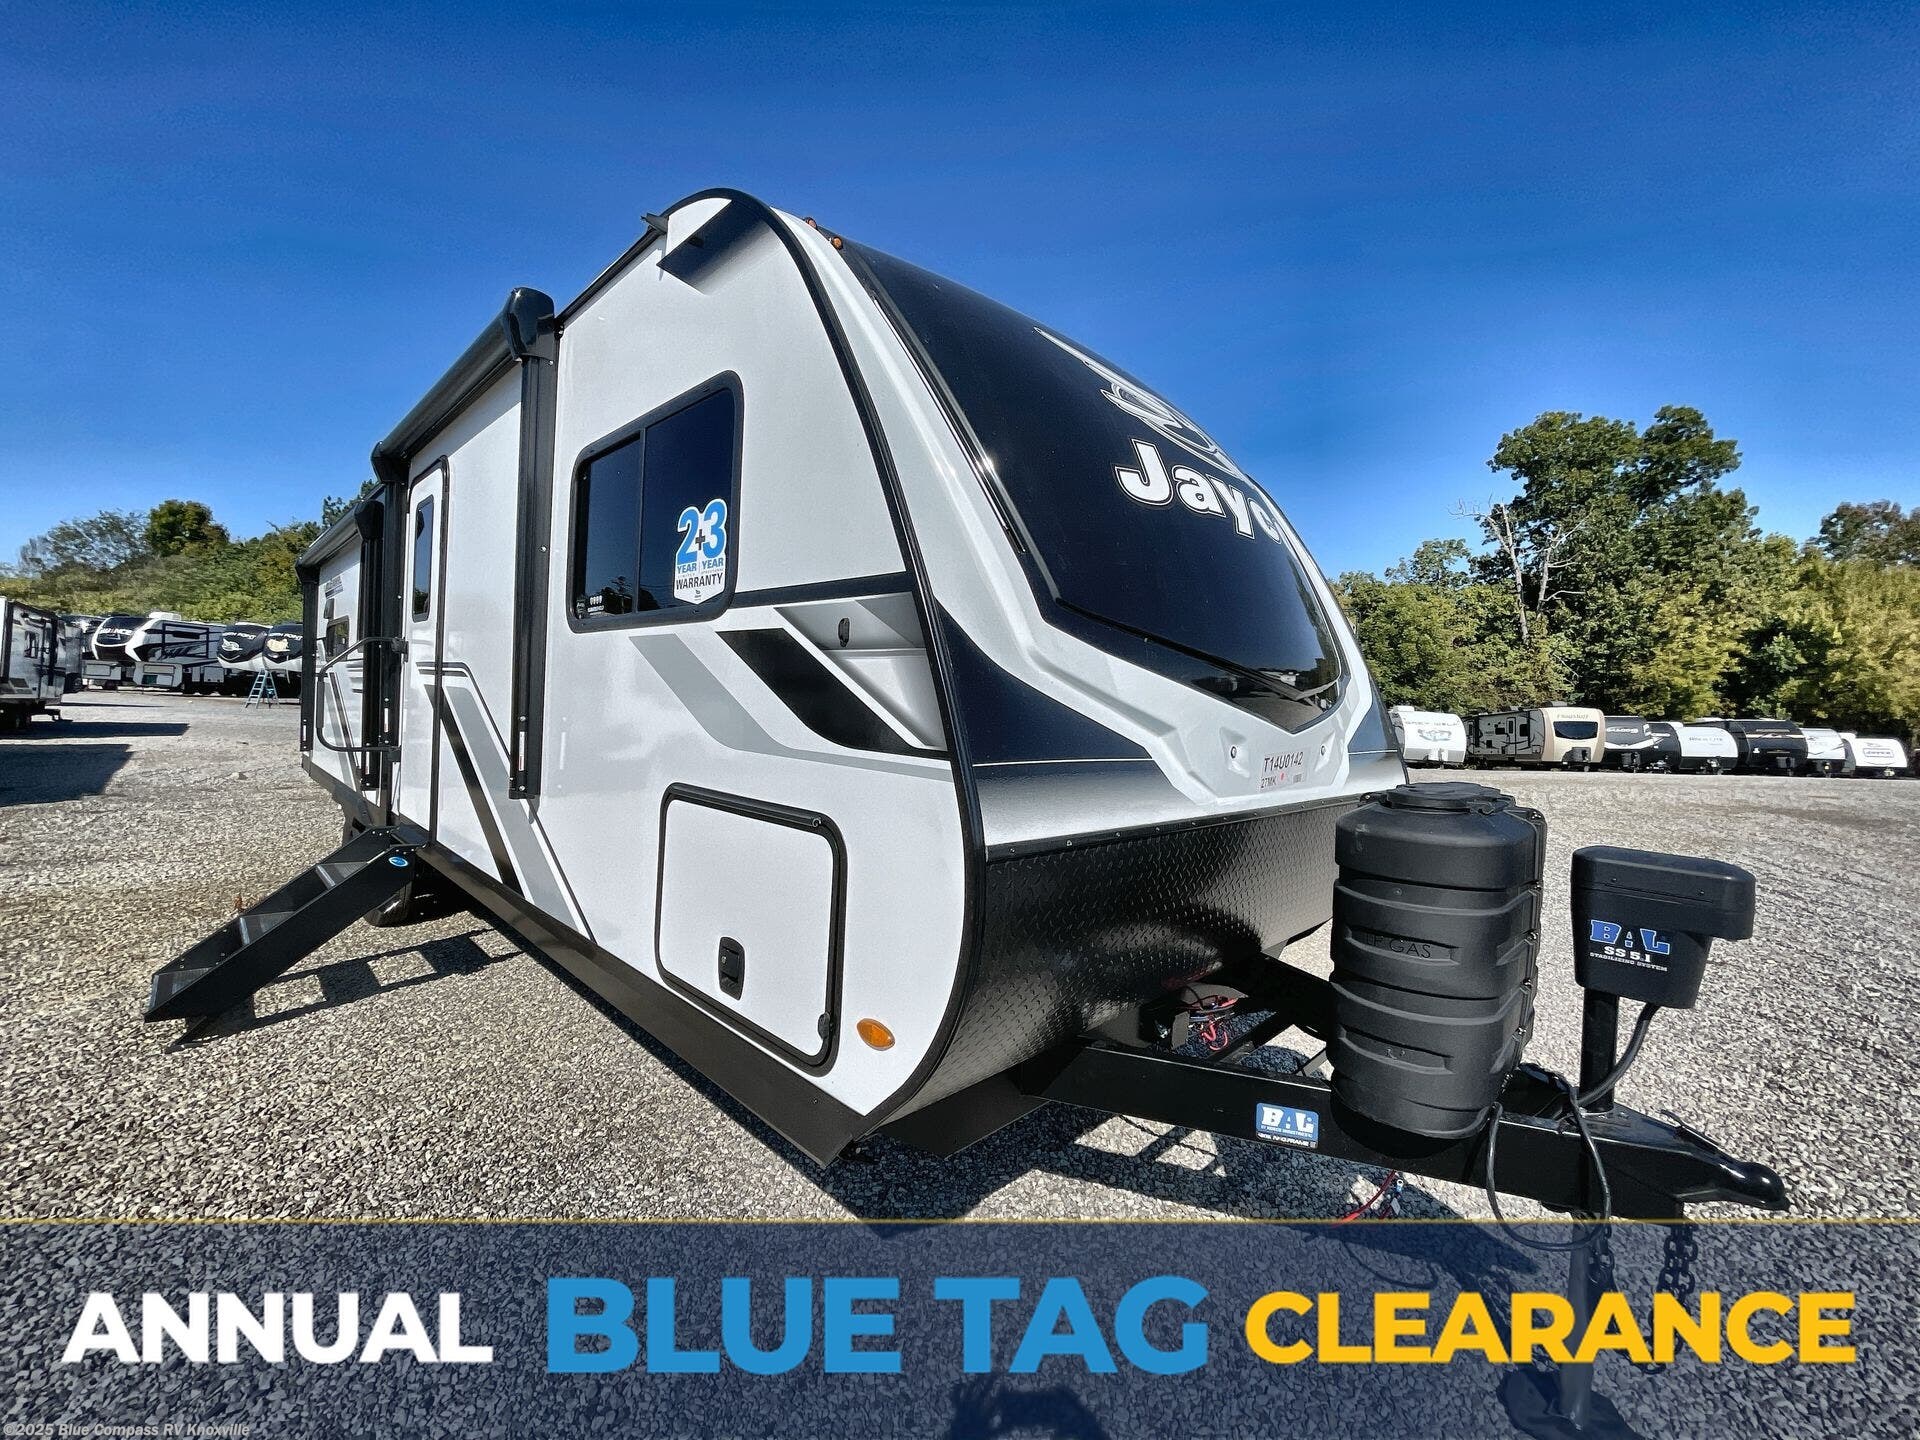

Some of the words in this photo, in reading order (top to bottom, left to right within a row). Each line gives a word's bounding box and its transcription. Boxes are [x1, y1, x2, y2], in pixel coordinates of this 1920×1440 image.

[1114, 438, 1281, 544] Jayc
[677, 563, 697, 574] YEAR
[701, 557, 724, 570] YEAR
[675, 572, 723, 590] WARRANTY
[1589, 919, 1671, 956] BAL
[1389, 938, 1431, 959] GAS
[1604, 945, 1626, 958] SS
[1589, 952, 1635, 965] STABILIZING
[1636, 961, 1668, 972] SYSTEM
[1261, 1106, 1314, 1134] BAL
